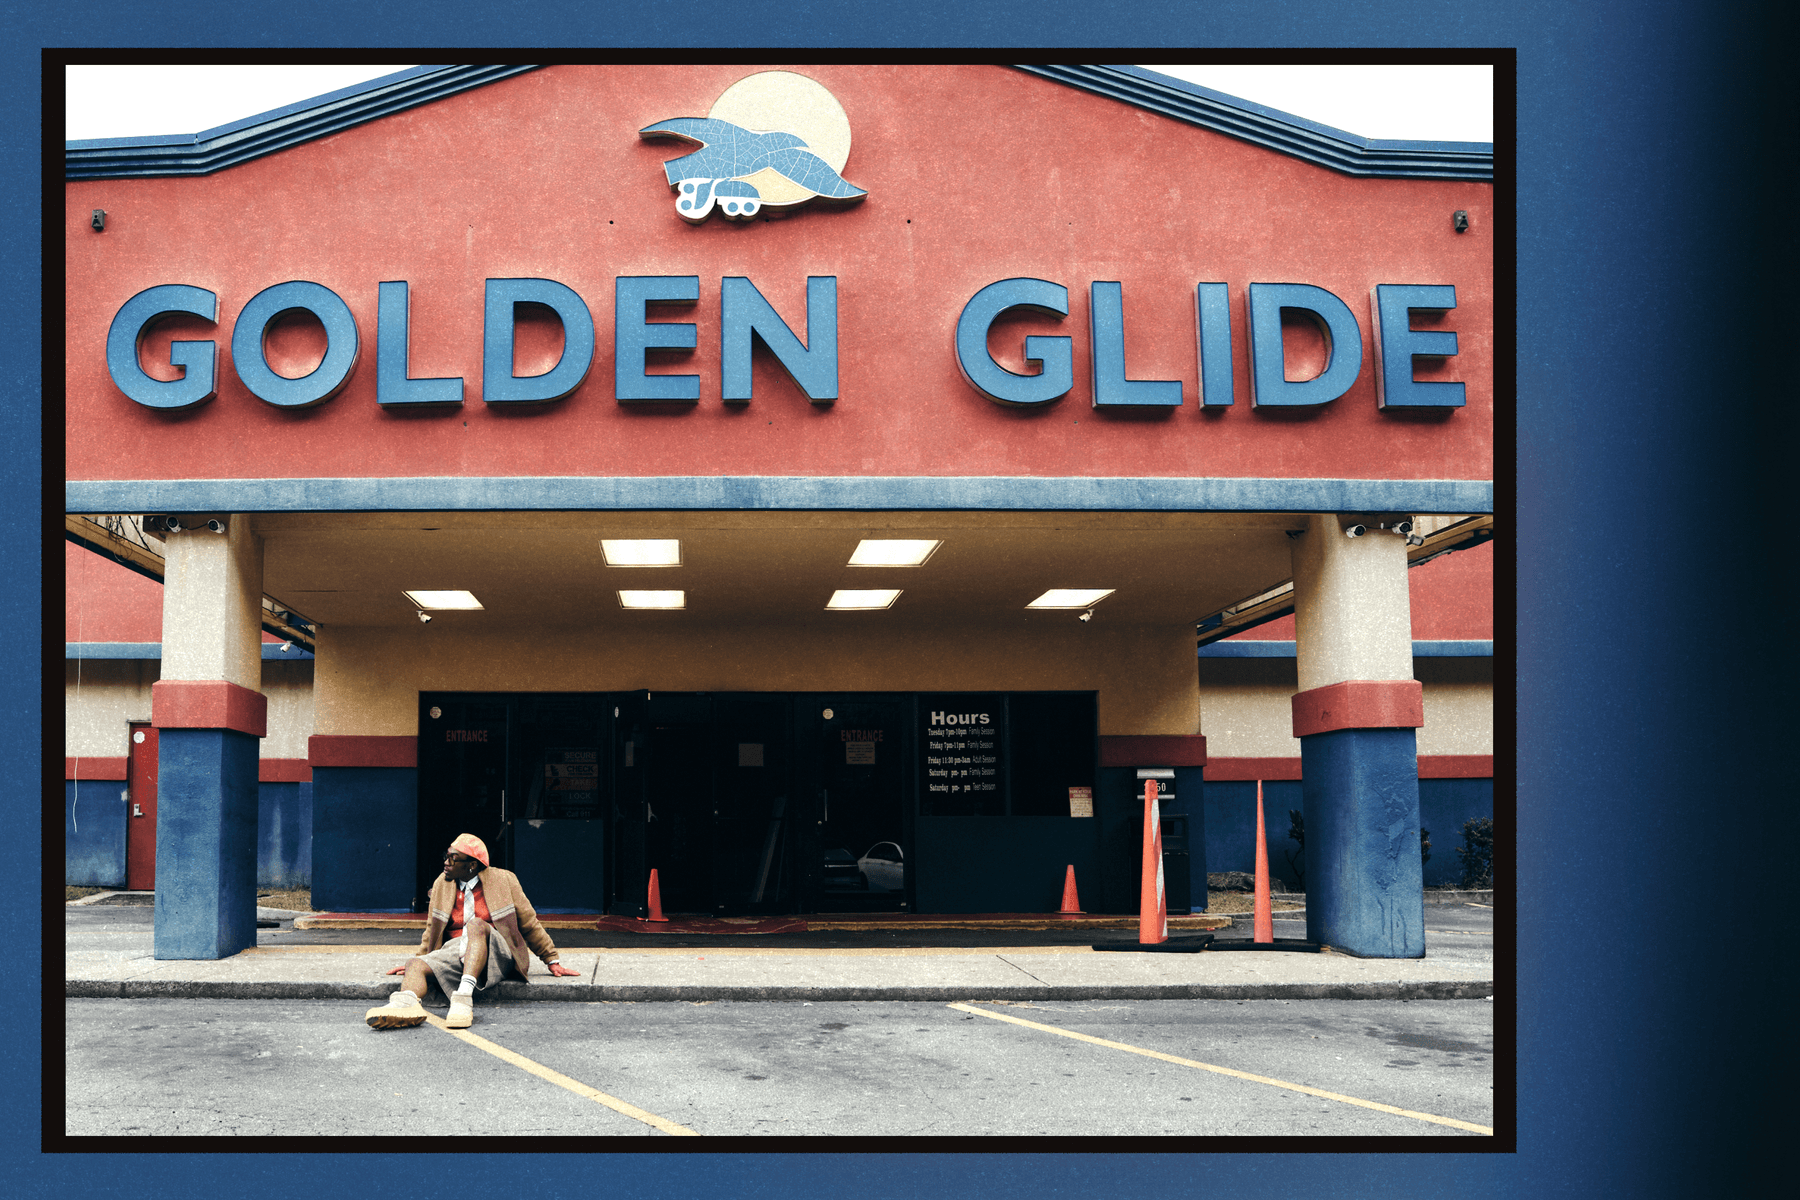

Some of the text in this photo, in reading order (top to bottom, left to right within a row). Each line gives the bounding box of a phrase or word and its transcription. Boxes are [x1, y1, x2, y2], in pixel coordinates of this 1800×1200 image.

[106, 275, 1467, 410] GOLDEN GLIDE
[931, 711, 990, 725] Hours
[446, 730, 488, 742] ENTRANCE
[841, 730, 883, 742] ENTRANCE
[928, 727, 945, 737] Tuesday
[968, 726, 980, 737] Family
[981, 726, 995, 735] Session
[929, 741, 943, 751] Friday
[967, 740, 979, 750] Family
[979, 740, 994, 749] Session
[927, 756, 941, 766] Friday
[972, 755, 982, 763] Adult
[982, 755, 996, 763] Session
[929, 769, 948, 778] Saturday
[969, 767, 981, 777] Family
[981, 767, 996, 776] Session
[929, 783, 949, 793] Saturday
[981, 782, 996, 791] Session
